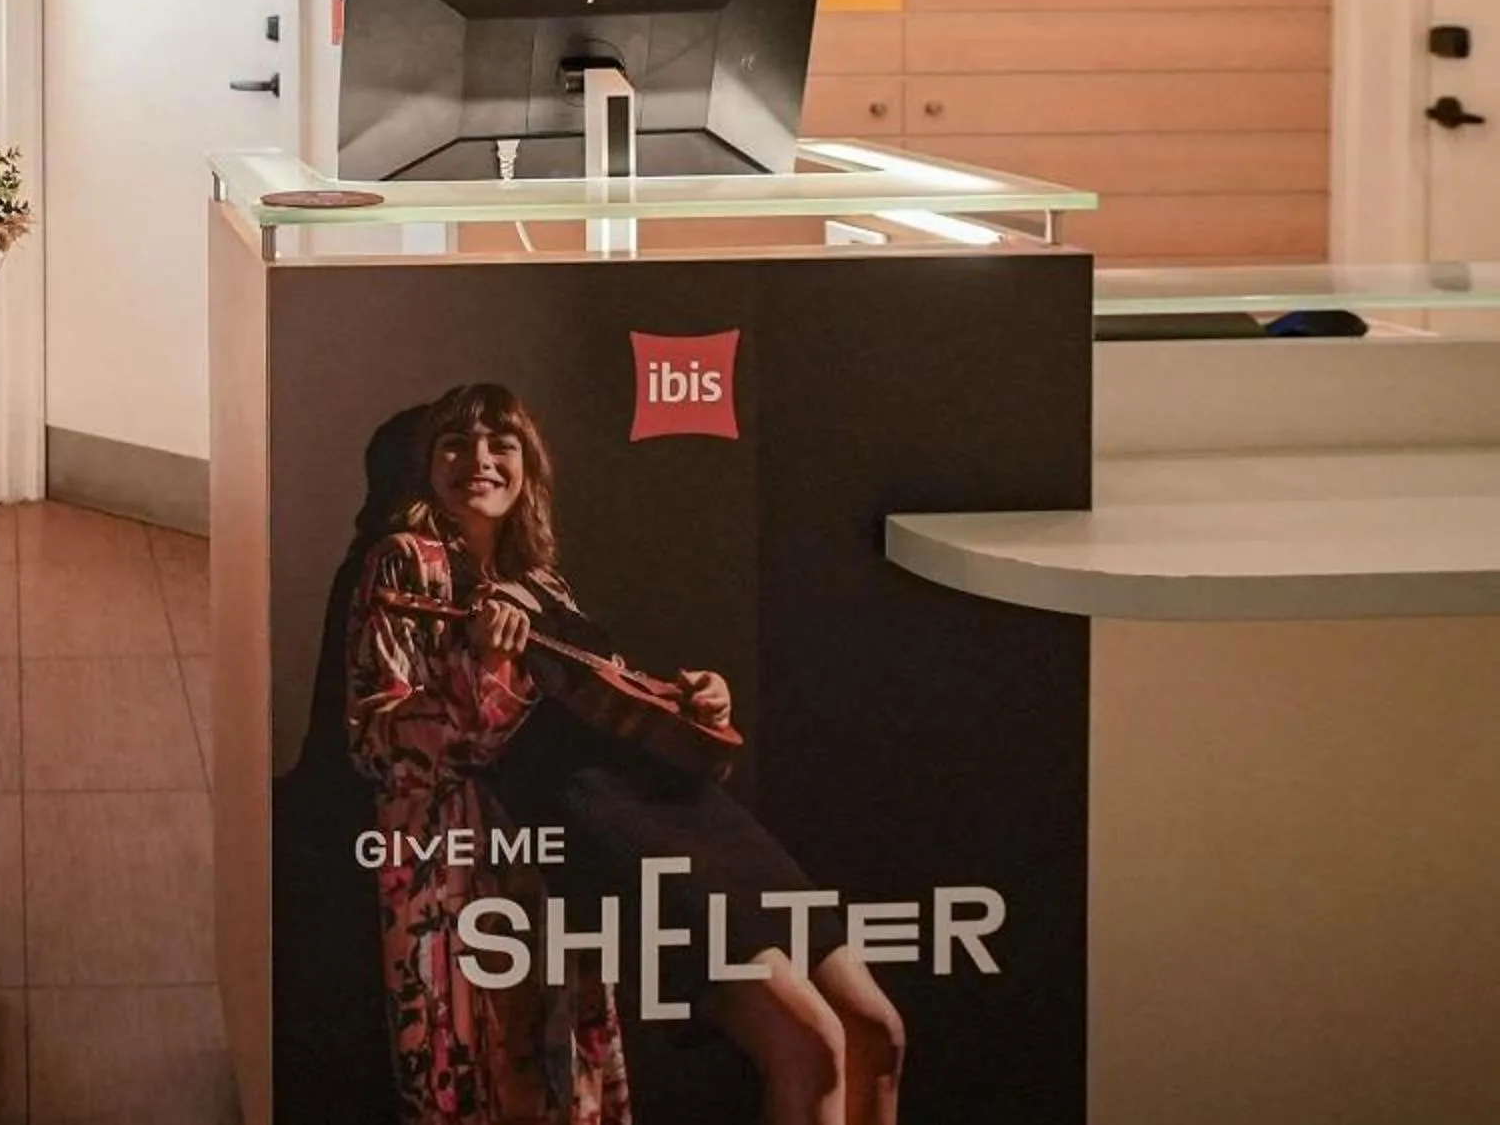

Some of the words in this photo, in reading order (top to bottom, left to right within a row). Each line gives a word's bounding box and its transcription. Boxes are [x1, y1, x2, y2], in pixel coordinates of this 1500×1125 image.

[648, 361, 722, 403] ibis
[355, 828, 474, 869] GIVE
[490, 827, 565, 864] ME
[457, 857, 1006, 1020] SHELTER
